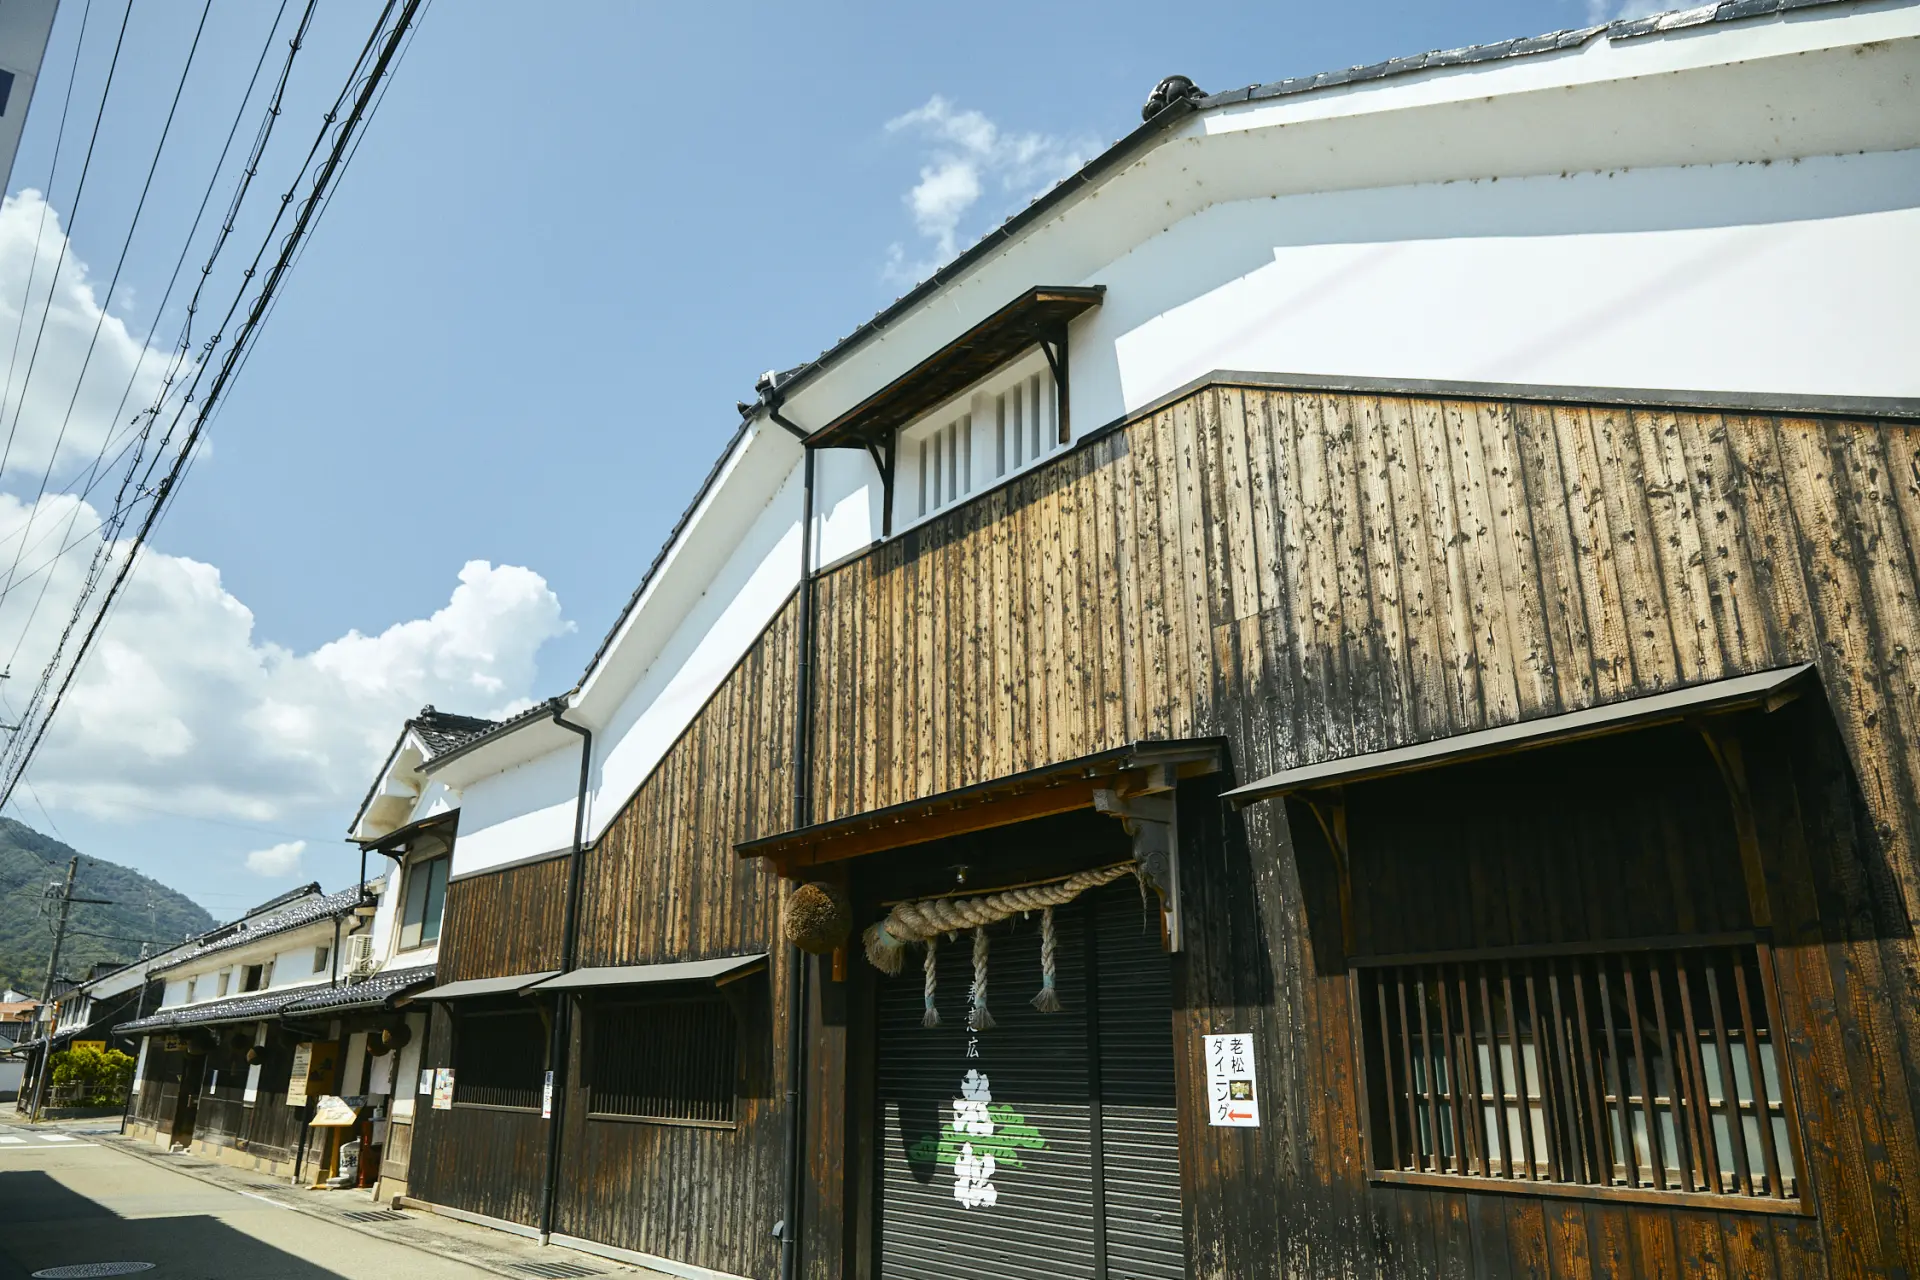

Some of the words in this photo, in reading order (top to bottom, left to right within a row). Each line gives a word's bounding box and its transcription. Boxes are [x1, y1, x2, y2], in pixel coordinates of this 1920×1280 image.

[1213, 1036, 1230, 1121] ダイニング
[1230, 1037, 1245, 1074] 老松
